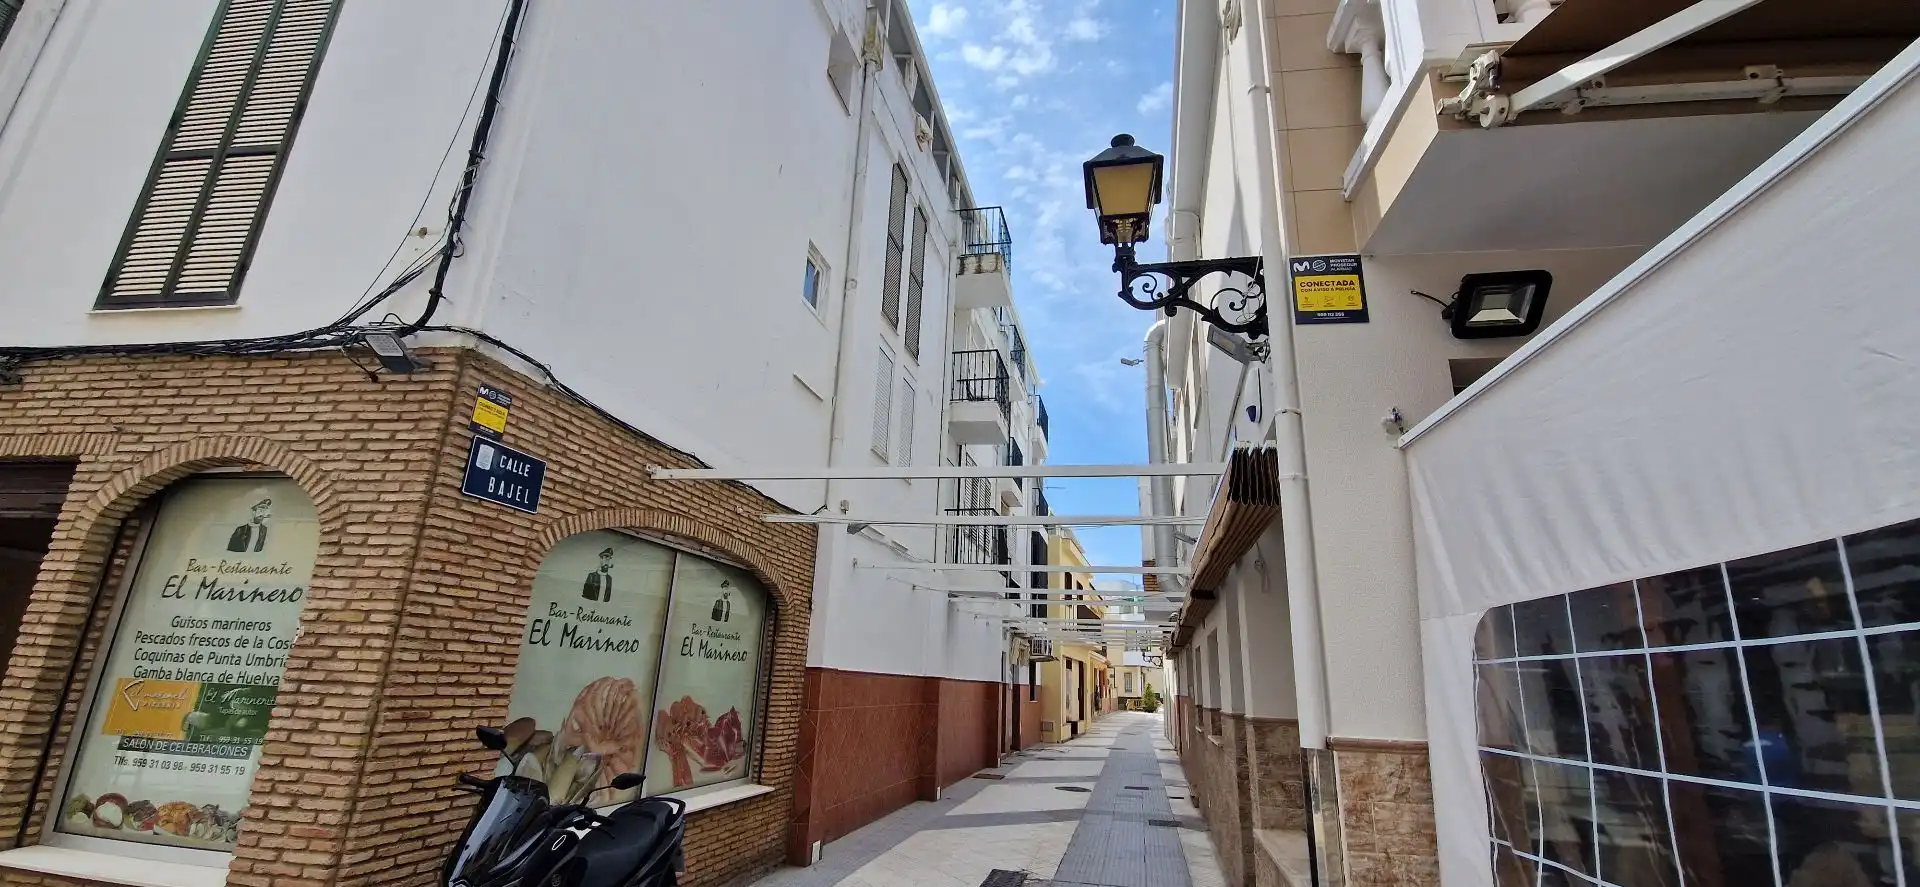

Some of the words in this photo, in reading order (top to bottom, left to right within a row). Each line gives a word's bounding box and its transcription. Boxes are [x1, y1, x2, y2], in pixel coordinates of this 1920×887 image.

[1299, 279, 1355, 287] CONECTADA
[499, 455, 531, 477] CALLE
[488, 476, 529, 504] BAJEL
[186, 558, 293, 575] Bar-Restaurante
[161, 574, 188, 599] El
[194, 576, 303, 603] Marinero
[171, 615, 208, 629] Guisos
[211, 618, 272, 632] marineros
[548, 602, 633, 627] Bar-Restaurante
[134, 630, 185, 646] Pescados
[188, 633, 231, 648] frescos
[234, 635, 250, 648] de
[253, 636, 263, 649] la
[528, 618, 551, 646] El
[559, 622, 640, 653] Marinero
[134, 647, 185, 664] Coquinas
[188, 650, 204, 664] de
[207, 651, 242, 666] Punta
[680, 636, 695, 657] El
[698, 638, 748, 661] Marinero
[133, 665, 172, 680] Gamba
[175, 667, 214, 682] blanca
[217, 669, 233, 684] de
[236, 671, 280, 685] Huelva
[205, 687, 218, 703] El
[220, 687, 276, 709] Marinerit
[155, 740, 169, 751] DE
[170, 742, 248, 757] CELEBRACIONES
[243, 737, 252, 745] 55
[132, 758, 147, 767] 959
[148, 759, 159, 768] 31
[161, 760, 171, 770] 03
[172, 761, 184, 771] 98
[190, 762, 206, 773] 959
[207, 764, 218, 773] 31
[220, 765, 232, 775] 55
[235, 766, 245, 776] 19
